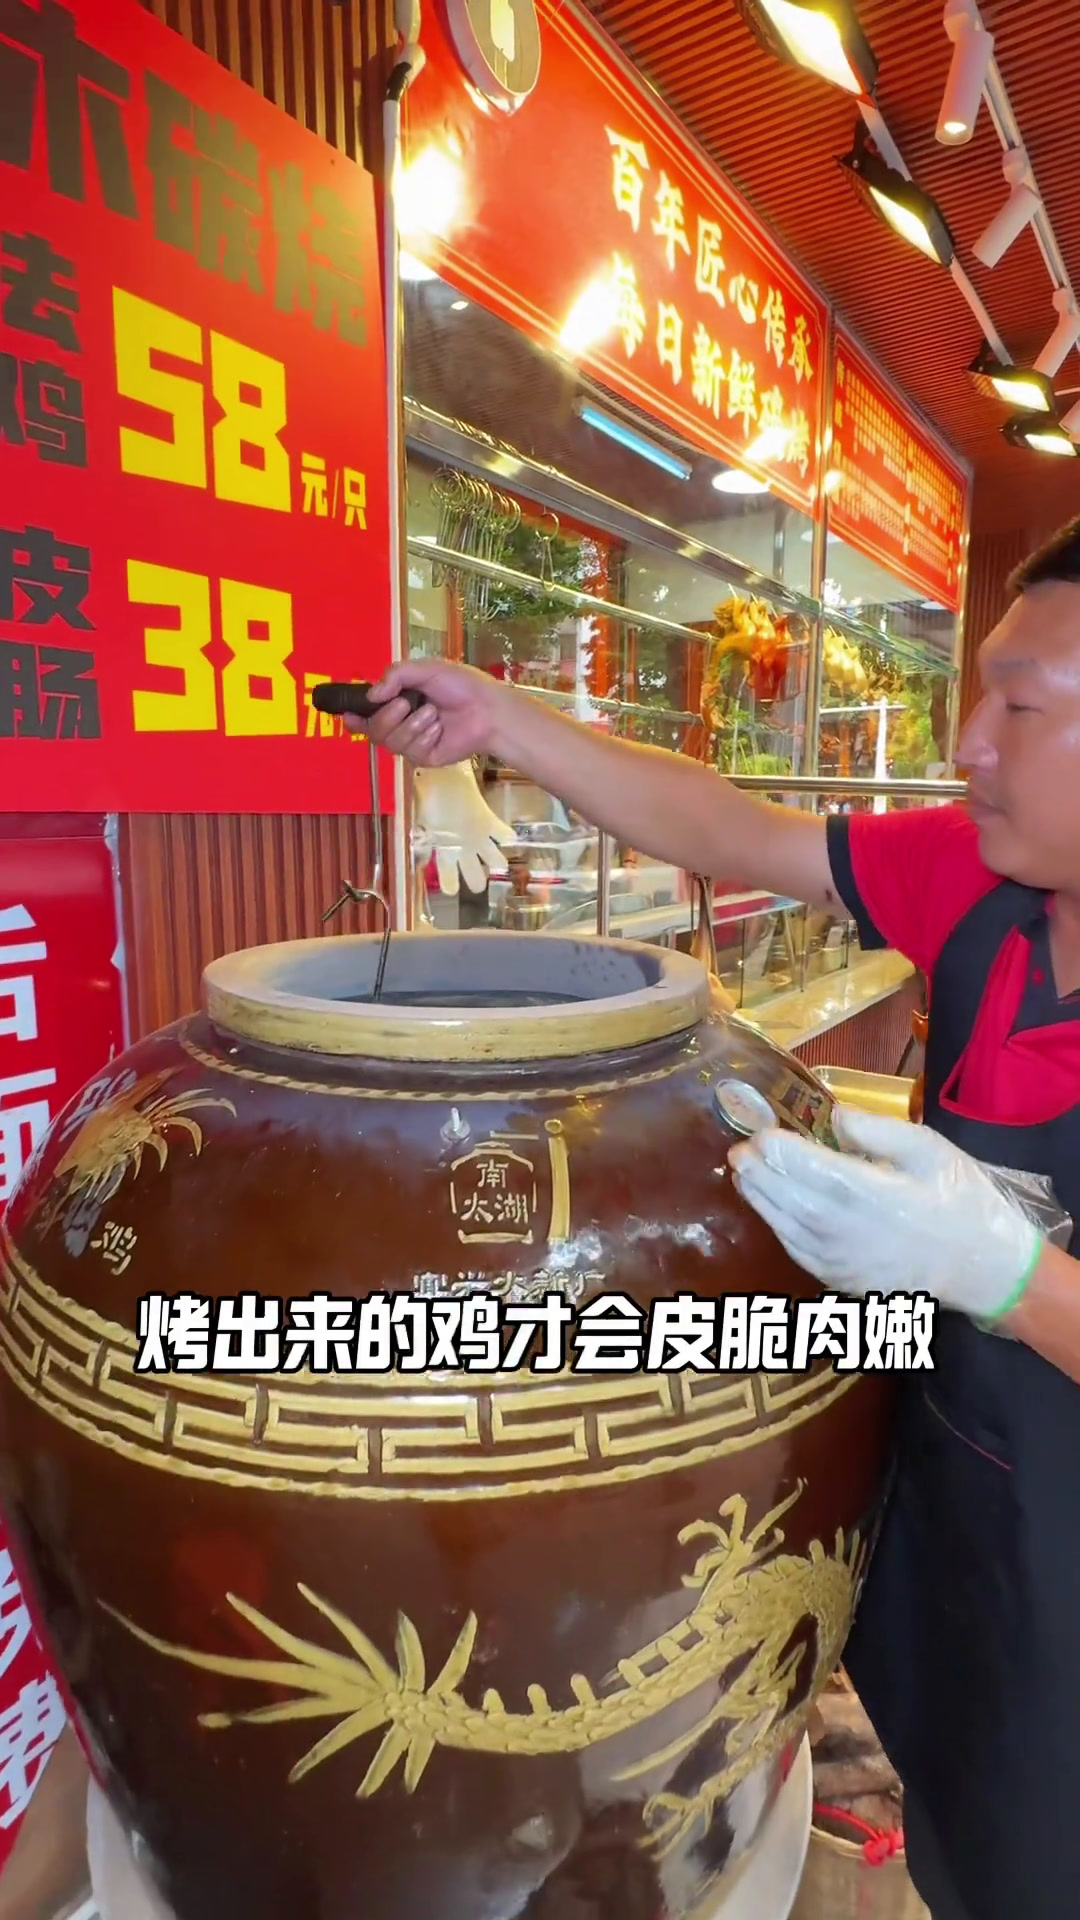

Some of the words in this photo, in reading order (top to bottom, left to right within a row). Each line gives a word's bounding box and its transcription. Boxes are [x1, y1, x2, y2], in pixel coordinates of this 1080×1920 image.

[605, 125, 814, 384] 百年匠心传承
[112, 285, 292, 513] 58
[301, 452, 367, 530] 元/只
[126, 558, 299, 737] 38
[476, 1158, 509, 1188] 南
